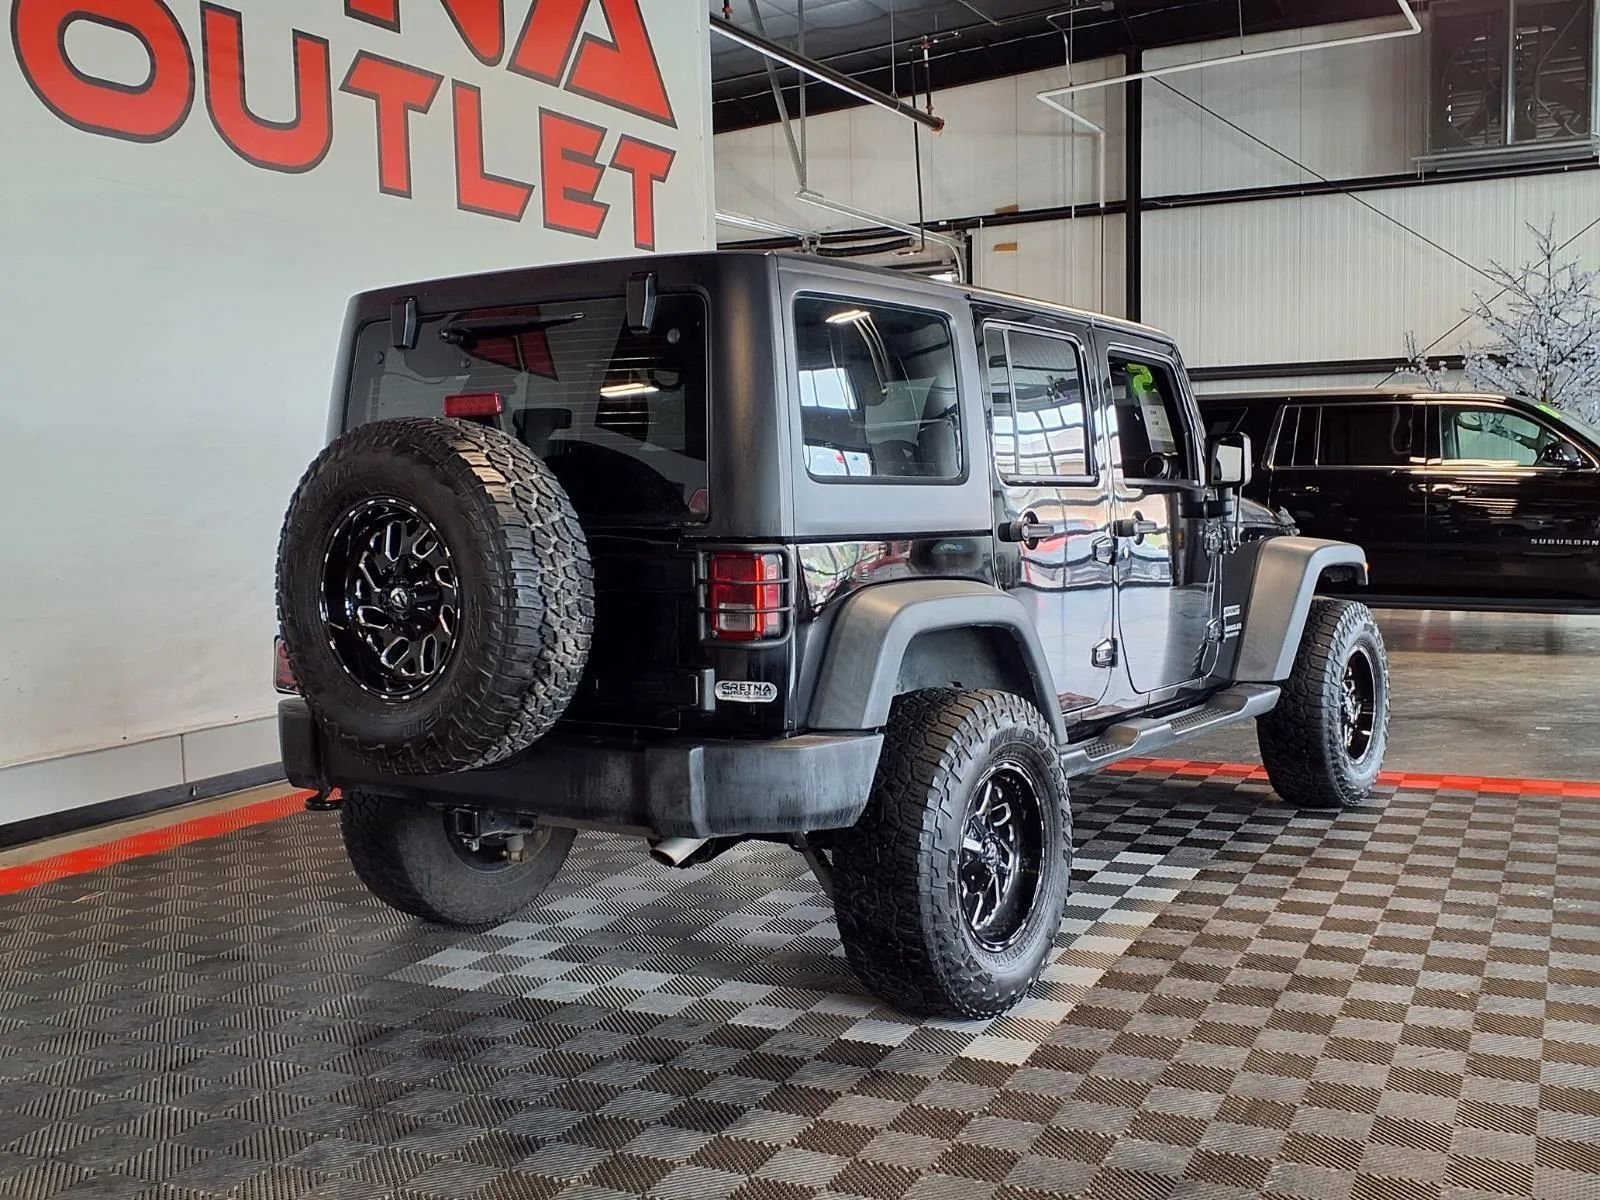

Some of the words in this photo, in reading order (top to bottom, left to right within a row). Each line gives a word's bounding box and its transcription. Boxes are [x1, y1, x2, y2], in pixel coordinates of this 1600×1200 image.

[11, 0, 676, 251] OUTLET
[1530, 538, 1599, 546] SUBURBAN
[721, 682, 772, 692] GRETNA
